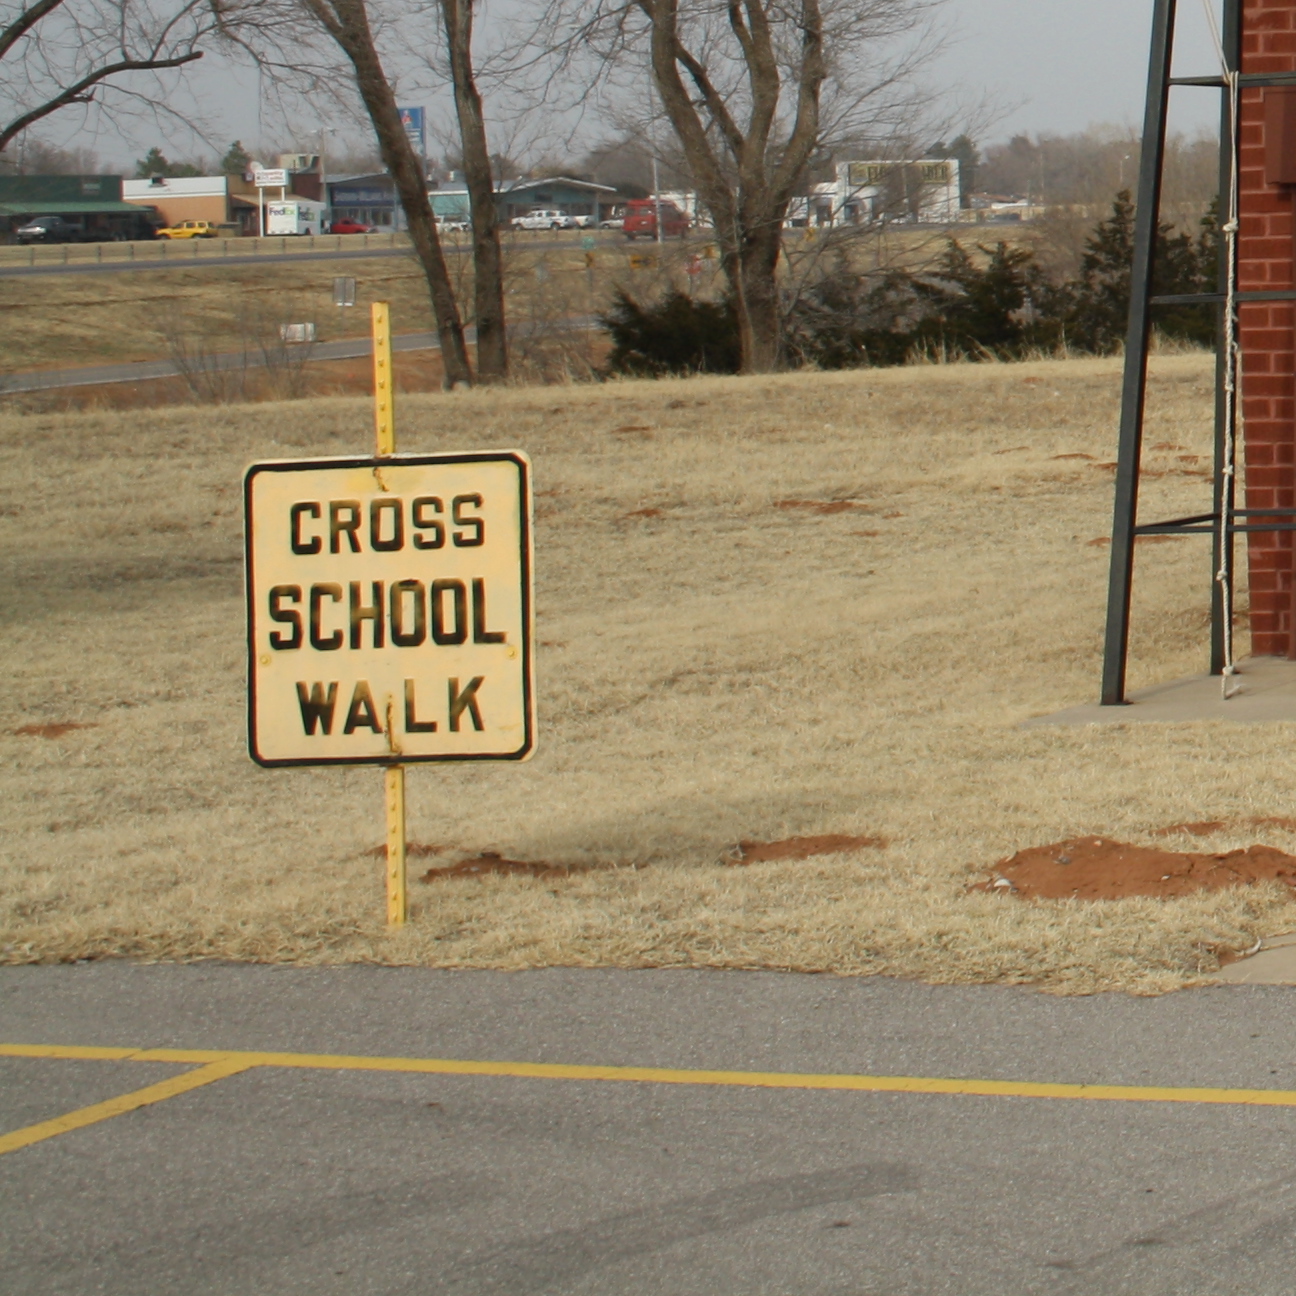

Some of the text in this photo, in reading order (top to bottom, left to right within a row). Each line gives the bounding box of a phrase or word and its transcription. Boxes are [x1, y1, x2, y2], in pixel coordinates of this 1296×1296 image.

[291, 493, 485, 555] CROSS
[269, 578, 507, 650] SCHOOL
[296, 676, 485, 736] WALK
